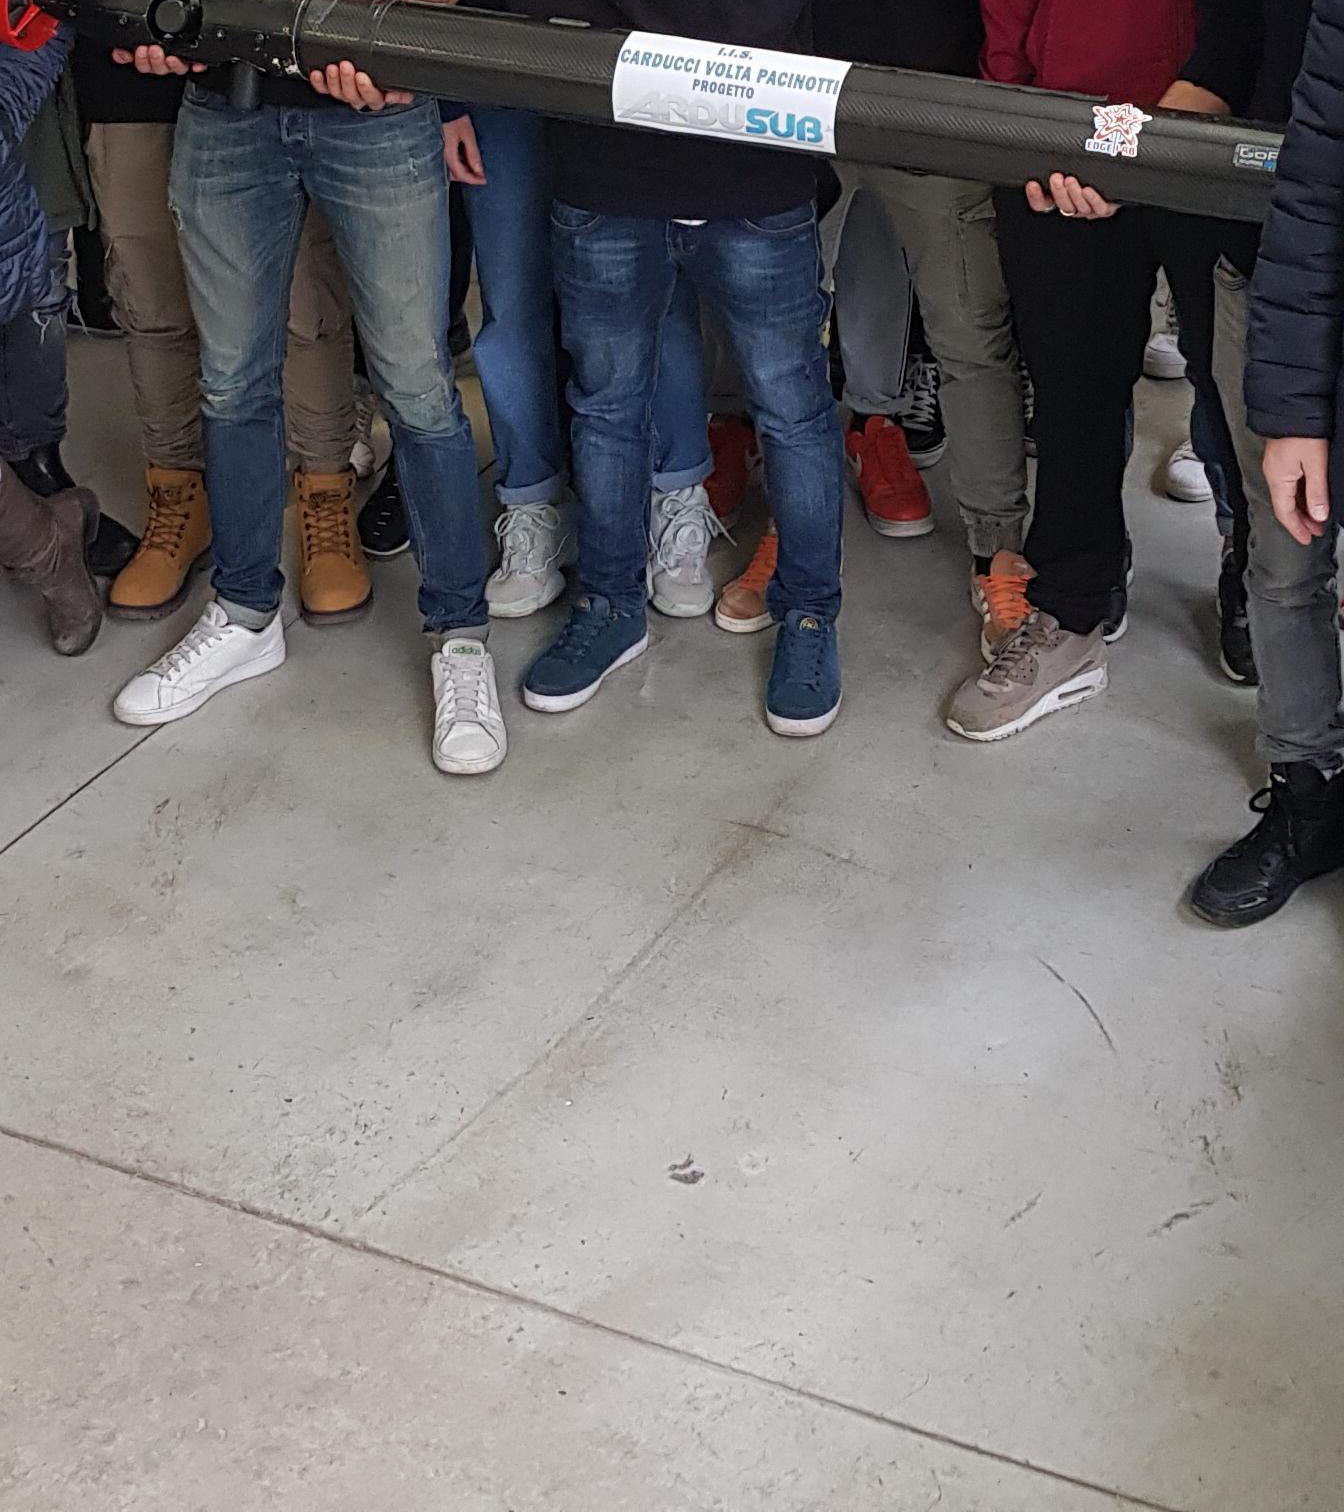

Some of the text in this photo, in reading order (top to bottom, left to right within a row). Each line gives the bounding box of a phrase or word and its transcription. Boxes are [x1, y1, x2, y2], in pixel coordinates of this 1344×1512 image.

[717, 47, 753, 60] I.I.S.
[620, 49, 840, 95] CARDUCCI VOLTA PACINOTTI
[692, 79, 755, 99] PROGETTO
[1086, 140, 1113, 152] EDGE
